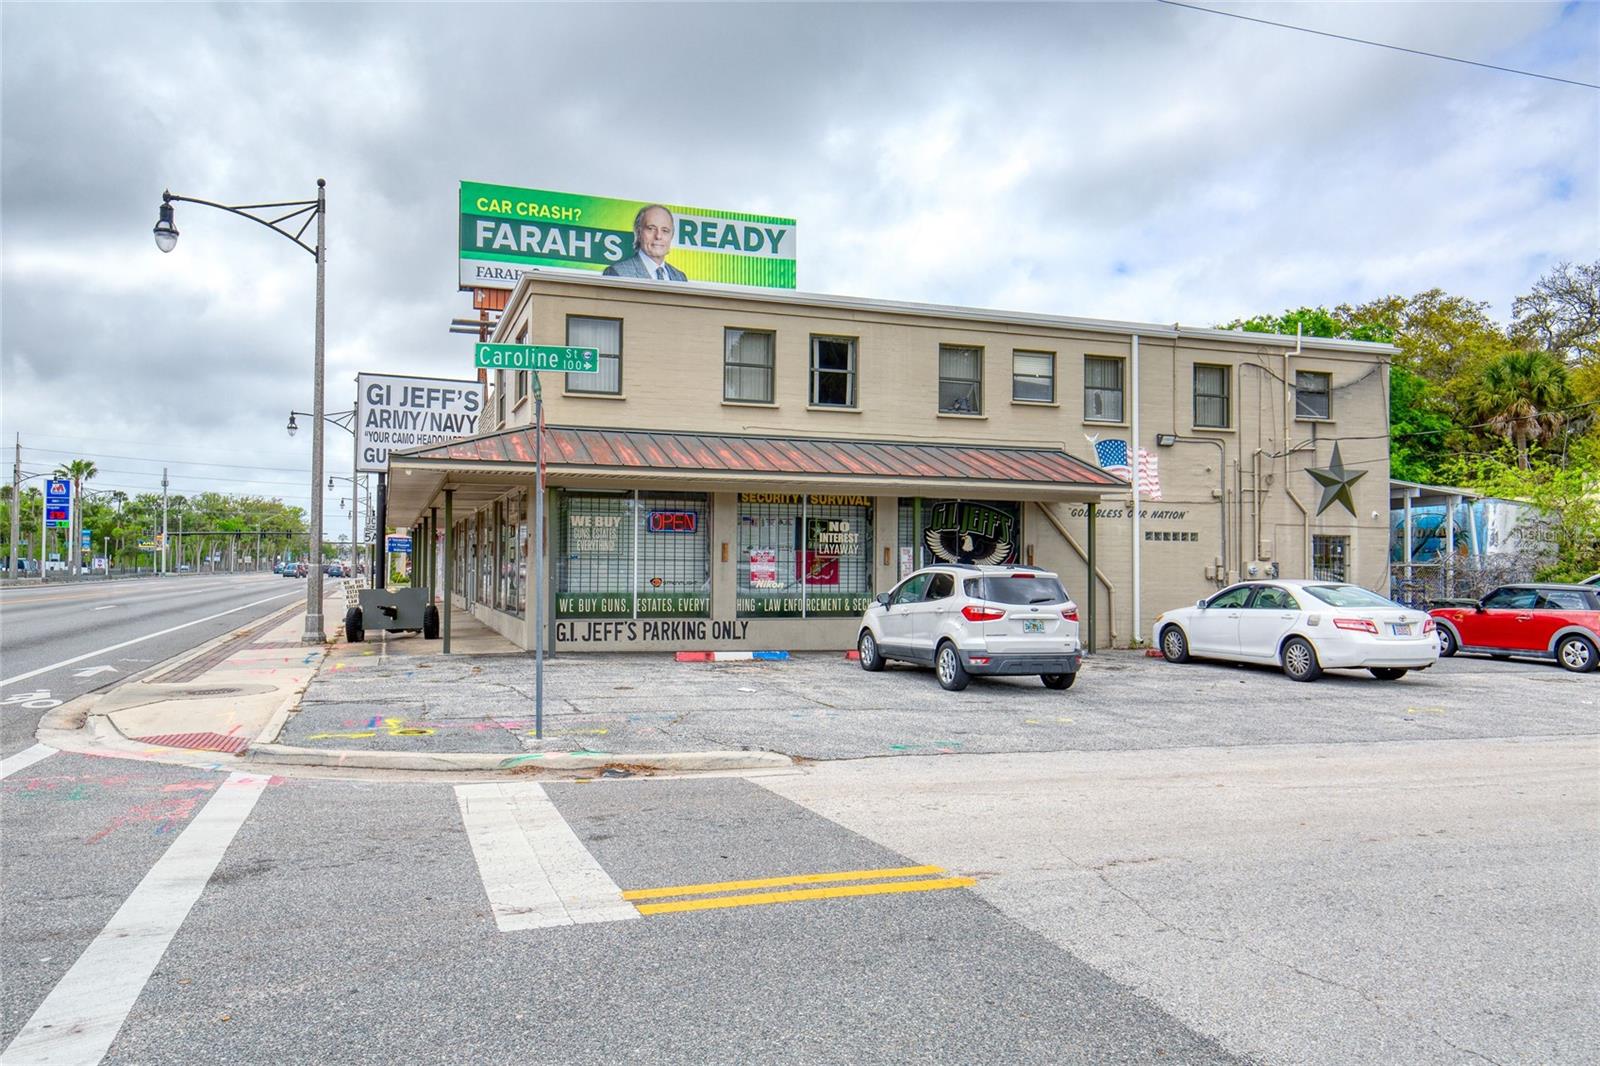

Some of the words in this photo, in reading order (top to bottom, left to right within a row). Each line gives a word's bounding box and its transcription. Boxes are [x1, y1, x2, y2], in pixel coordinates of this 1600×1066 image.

[476, 197, 513, 215] CAR
[516, 201, 582, 222] CRASH?
[475, 219, 624, 262] FARAH'S
[678, 218, 787, 254] READY
[479, 345, 559, 368] Caroline
[565, 348, 579, 360] St
[563, 359, 582, 371] 100
[366, 383, 392, 406] GI
[400, 386, 480, 412] JEFF'S
[365, 408, 479, 434] ARMY/NAVY
[391, 433, 415, 444] CAMO
[741, 491, 800, 504] SECURITY
[809, 494, 871, 506] SURVIVAL
[1095, 508, 1123, 519] BLESS
[570, 515, 592, 527] WE
[594, 516, 621, 528] BUY
[651, 512, 695, 531] OPEN
[828, 521, 850, 532] NO
[819, 532, 859, 543] INTEREST
[819, 544, 859, 555] LAYAWAY
[754, 579, 785, 589] Nikon
[559, 598, 574, 613] WE
[578, 598, 598, 613] BUY
[764, 598, 781, 612] LAW
[582, 621, 638, 642] JEFF'S
[642, 621, 707, 641] PARKING
[711, 620, 750, 641] ONLY
